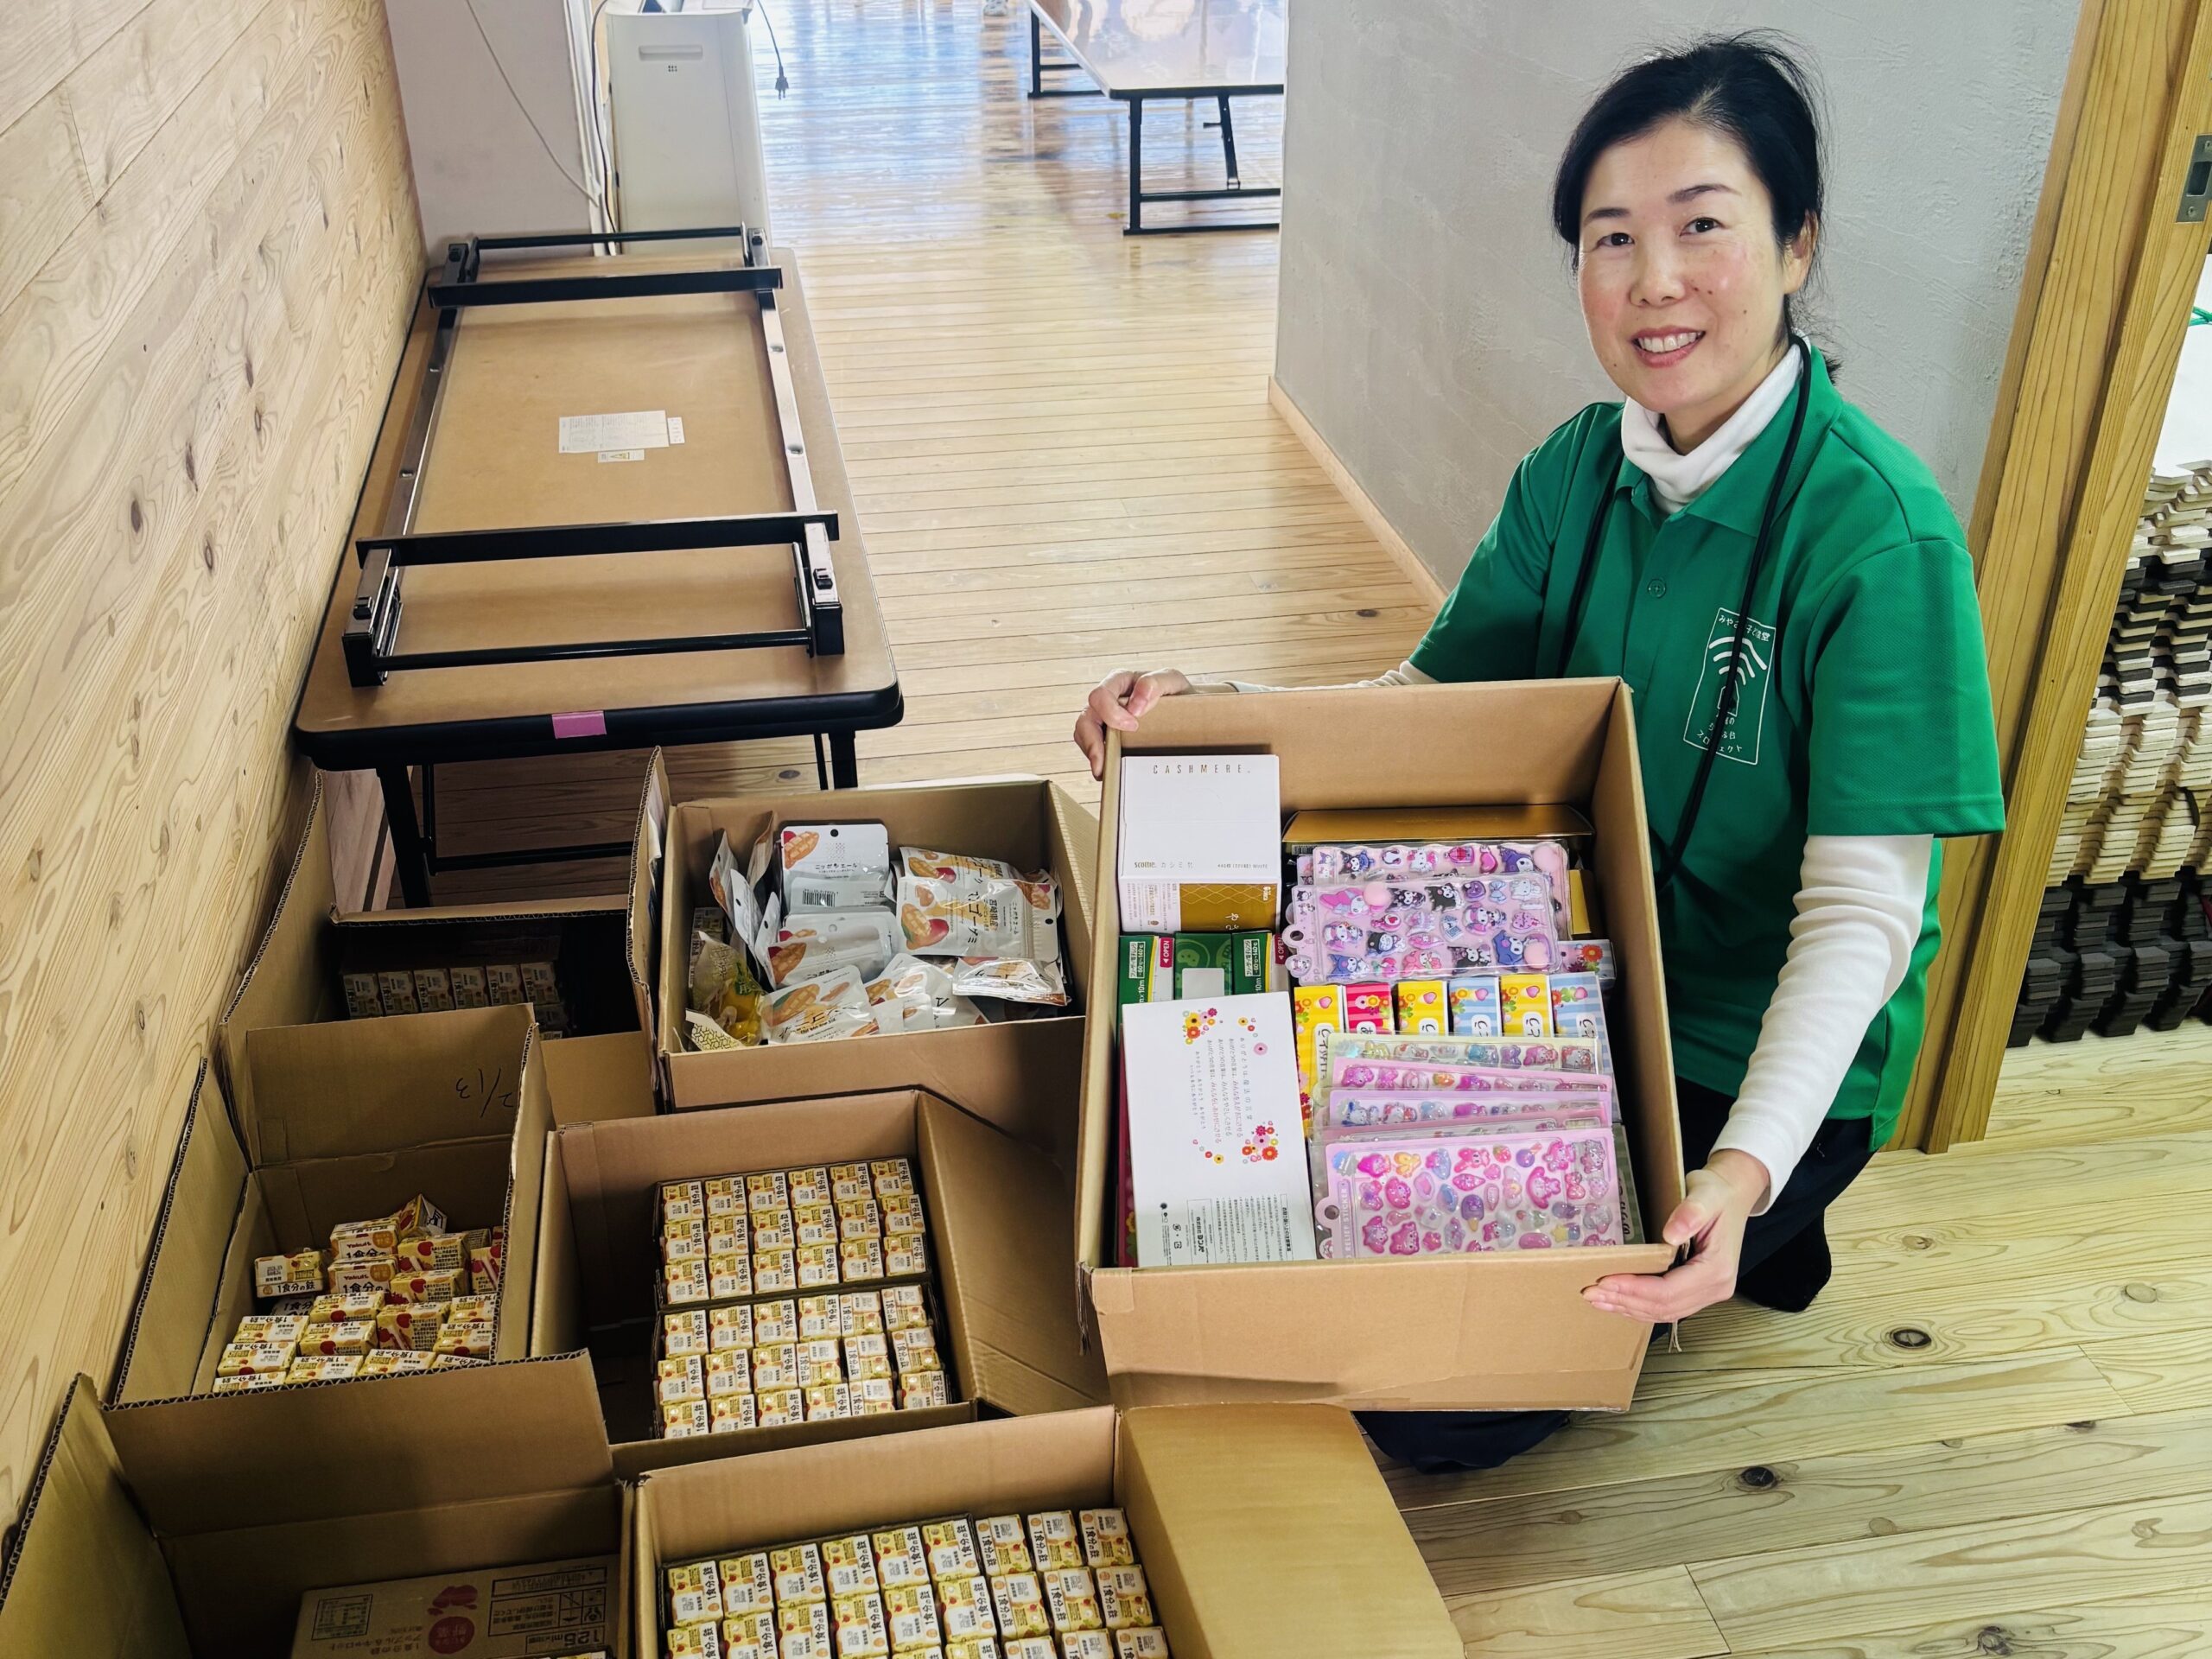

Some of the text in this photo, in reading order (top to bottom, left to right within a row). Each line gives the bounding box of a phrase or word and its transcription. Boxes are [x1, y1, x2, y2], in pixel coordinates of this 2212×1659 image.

[1697, 729, 1742, 753] プロェクト
[277, 1281, 315, 1293] 1食分の鉄
[857, 1541, 871, 1574] 1食分の鉄
[907, 1531, 922, 1565] 1食分の鉄
[957, 1525, 972, 1557] 1食分の鉄
[982, 1535, 997, 1567] 1食分の鉄
[1033, 1530, 1048, 1563] 1食分の鉄
[1085, 1526, 1100, 1558] 1食分の鉄
[754, 1555, 767, 1592] 1食分の鉄
[805, 1549, 819, 1583] 1食分の鉄
[703, 1566, 716, 1600] 1食分の鉄
[868, 1599, 881, 1634] 1食分の鉄
[920, 1591, 935, 1624] 1食分の鉄
[974, 1582, 988, 1618] 1食分の鉄
[997, 1593, 1014, 1628] 1食分の鉄
[1052, 1587, 1066, 1622] 1食分の鉄
[1103, 1585, 1119, 1618] 1食分の鉄
[760, 1618, 773, 1653] 1食分の鉄
[813, 1609, 826, 1643] 1食分の鉄
[703, 1627, 716, 1659] 食分の鉄
